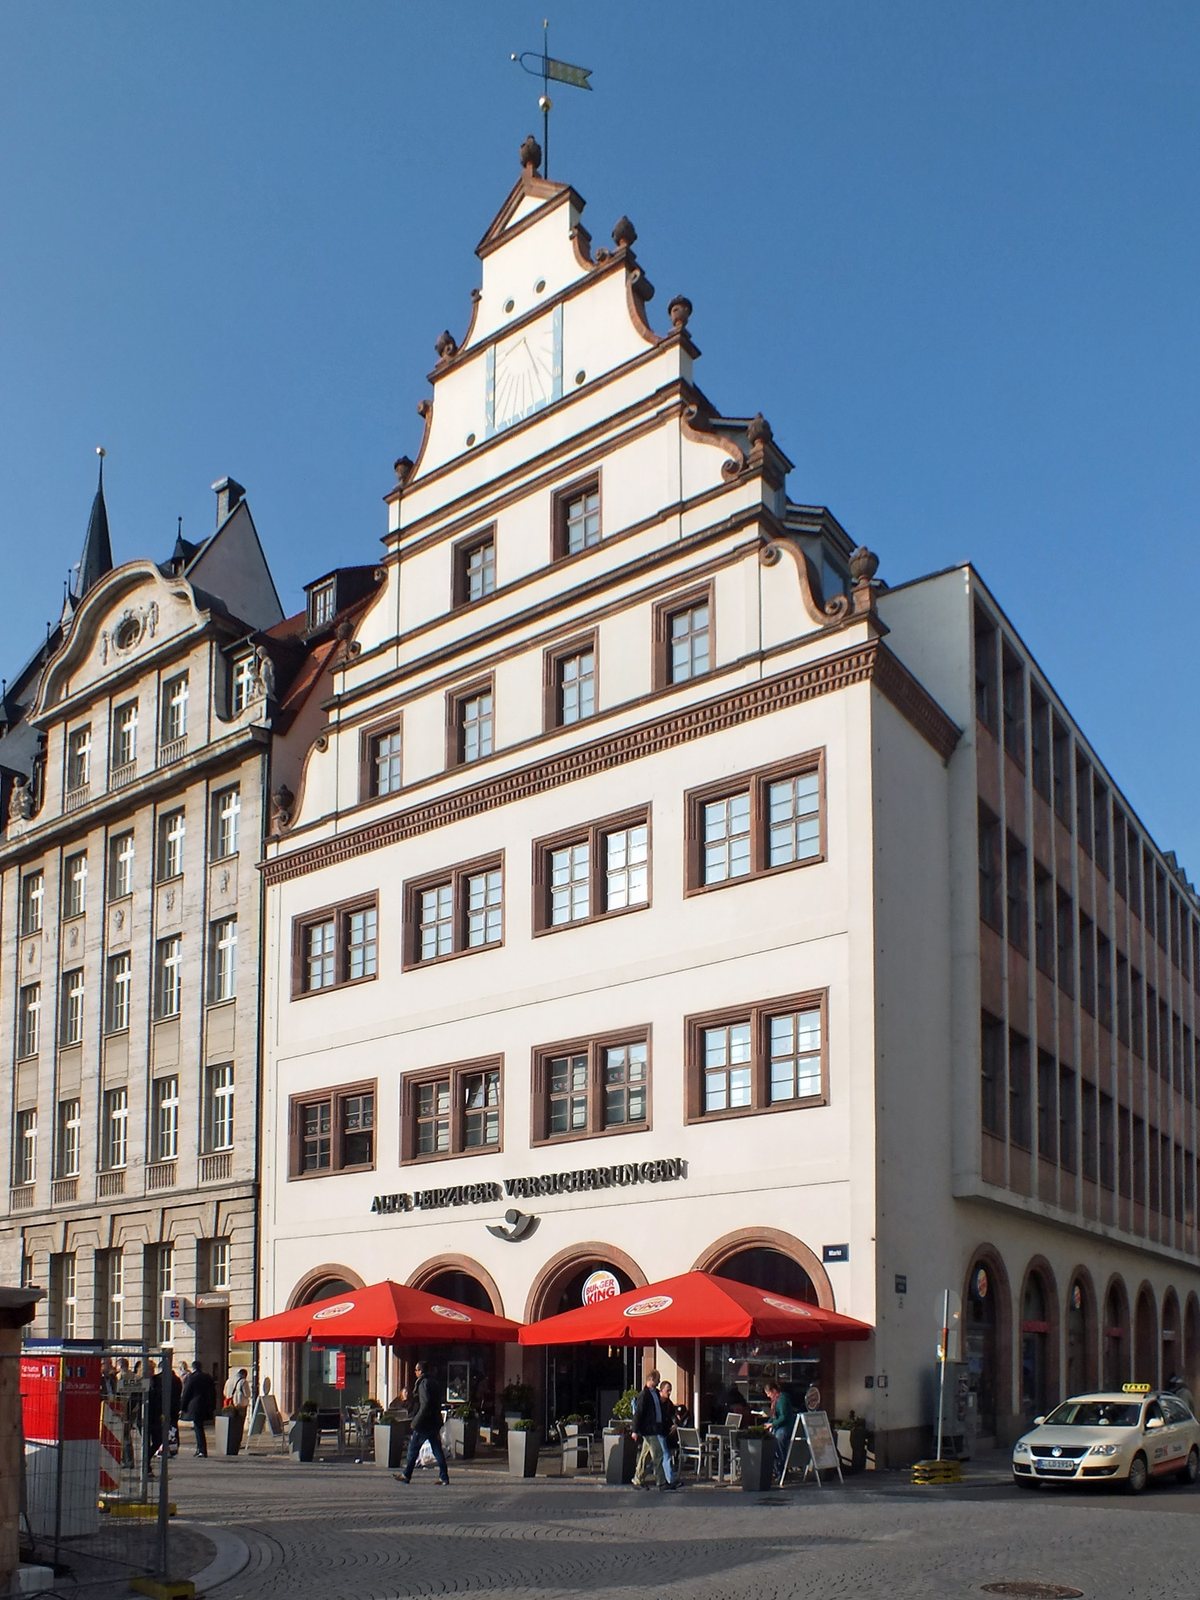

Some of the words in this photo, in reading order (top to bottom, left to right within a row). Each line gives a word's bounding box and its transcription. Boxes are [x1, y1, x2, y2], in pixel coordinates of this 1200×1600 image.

[370, 1194, 411, 1213] ALTE
[413, 1182, 500, 1208] LEIPZIGER
[503, 1158, 684, 1198] VERSICHERUNGEN
[585, 1279, 614, 1296] BURGER
[587, 1287, 615, 1304] KING
